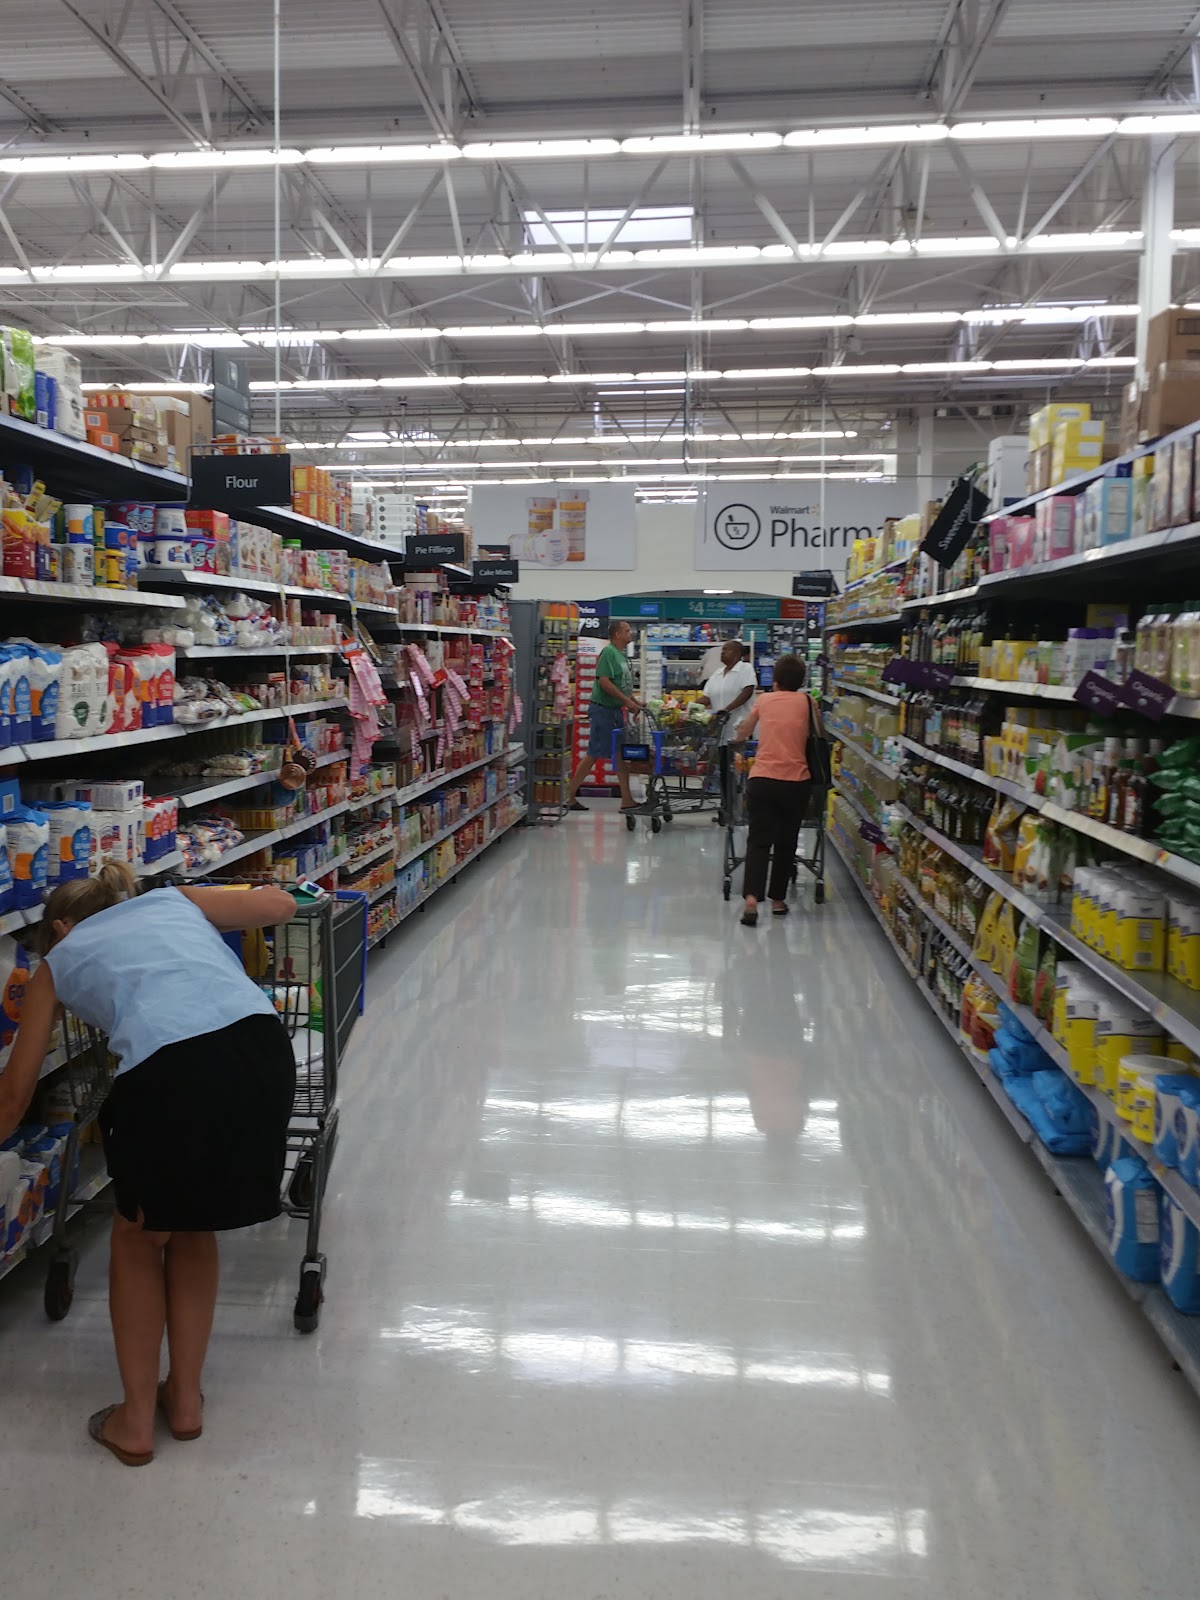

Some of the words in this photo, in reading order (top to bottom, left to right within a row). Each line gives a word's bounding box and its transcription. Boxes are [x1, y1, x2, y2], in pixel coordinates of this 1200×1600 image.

[225, 475, 259, 489] Flour
[769, 505, 810, 515] Walmart
[415, 546, 427, 554] Pie
[428, 545, 456, 554] Fillings
[797, 583, 827, 592] Shortening
[688, 601, 705, 615] $4
